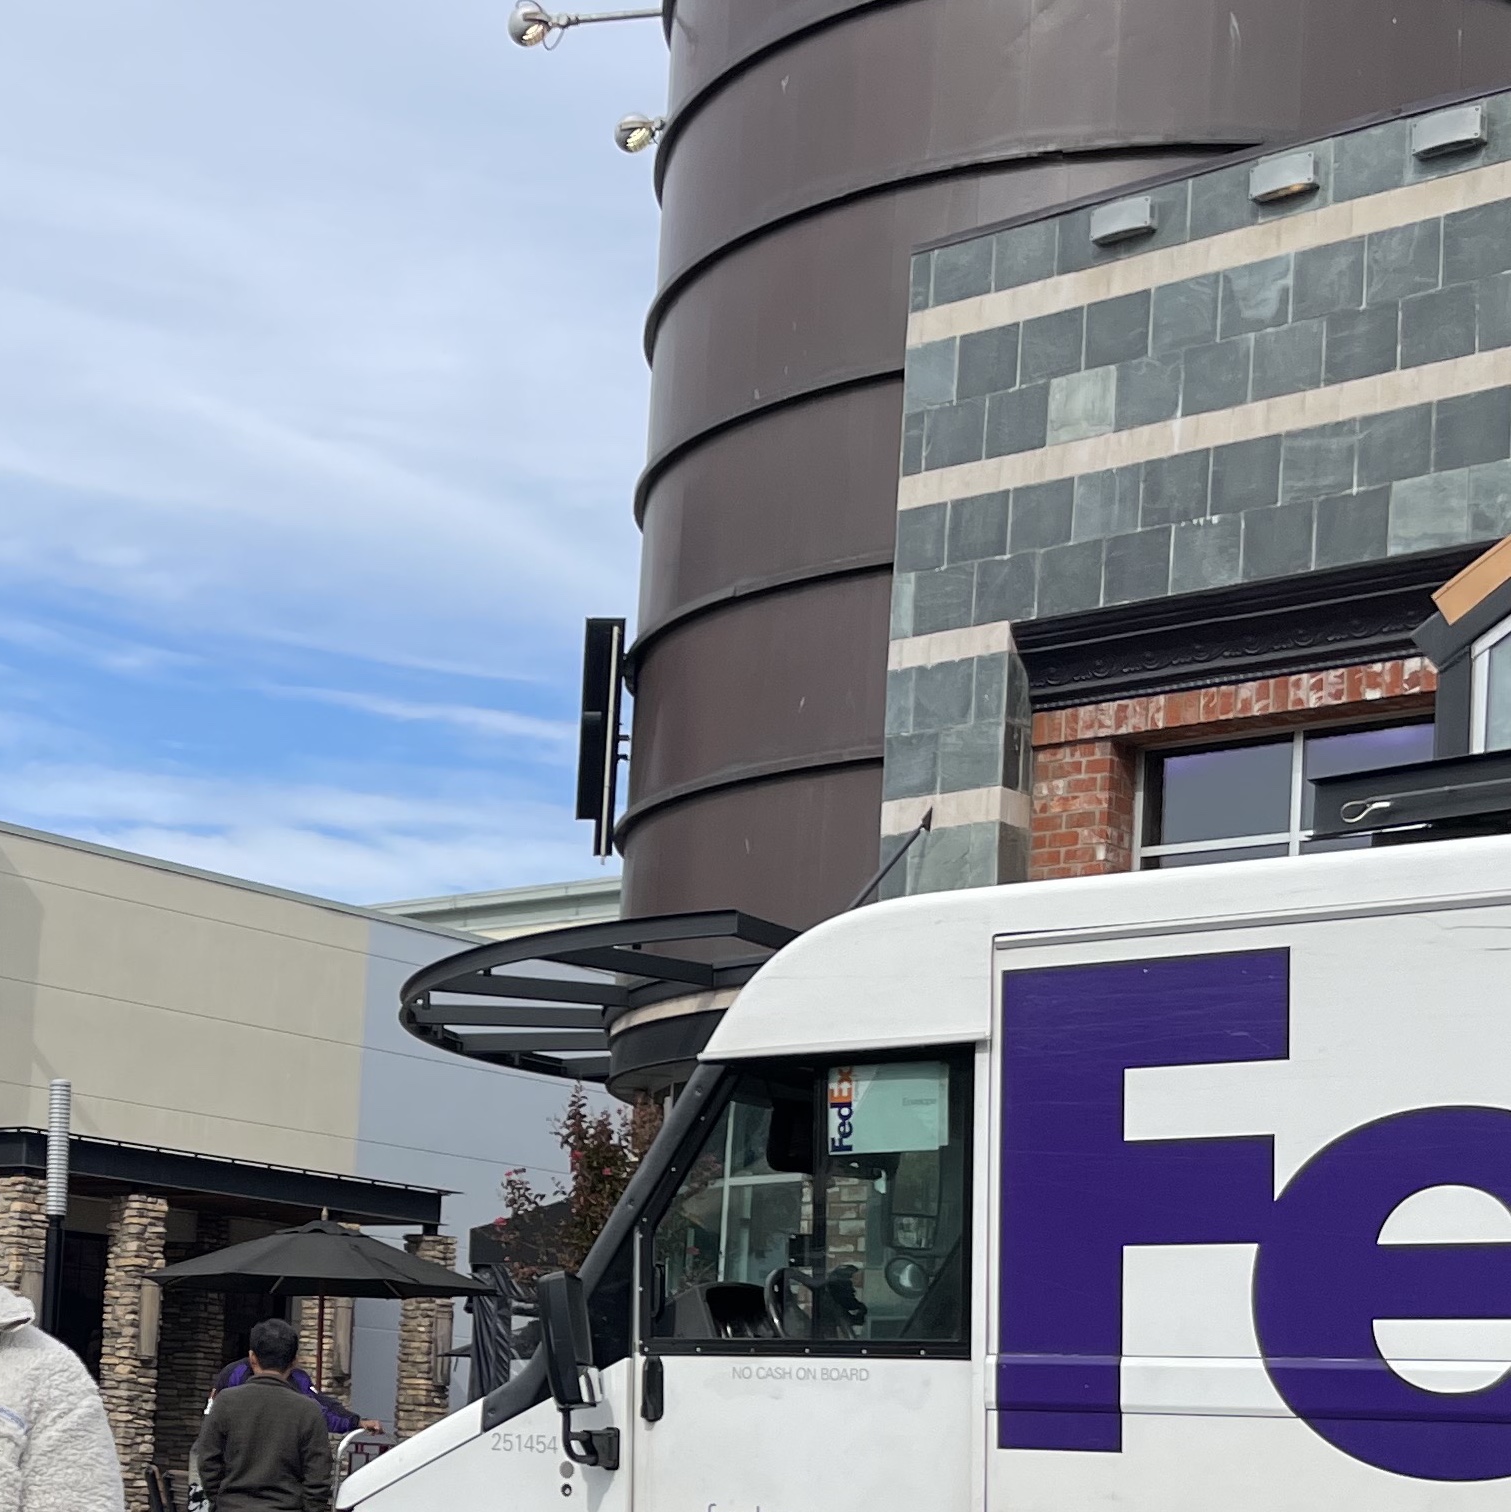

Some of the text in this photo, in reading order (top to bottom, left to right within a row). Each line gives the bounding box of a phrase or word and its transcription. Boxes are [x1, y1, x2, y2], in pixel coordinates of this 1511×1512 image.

[829, 1066, 853, 1152] FedEx
[731, 1366, 870, 1382] NO CASH ON BOARD
[491, 1432, 558, 1455] 251454
